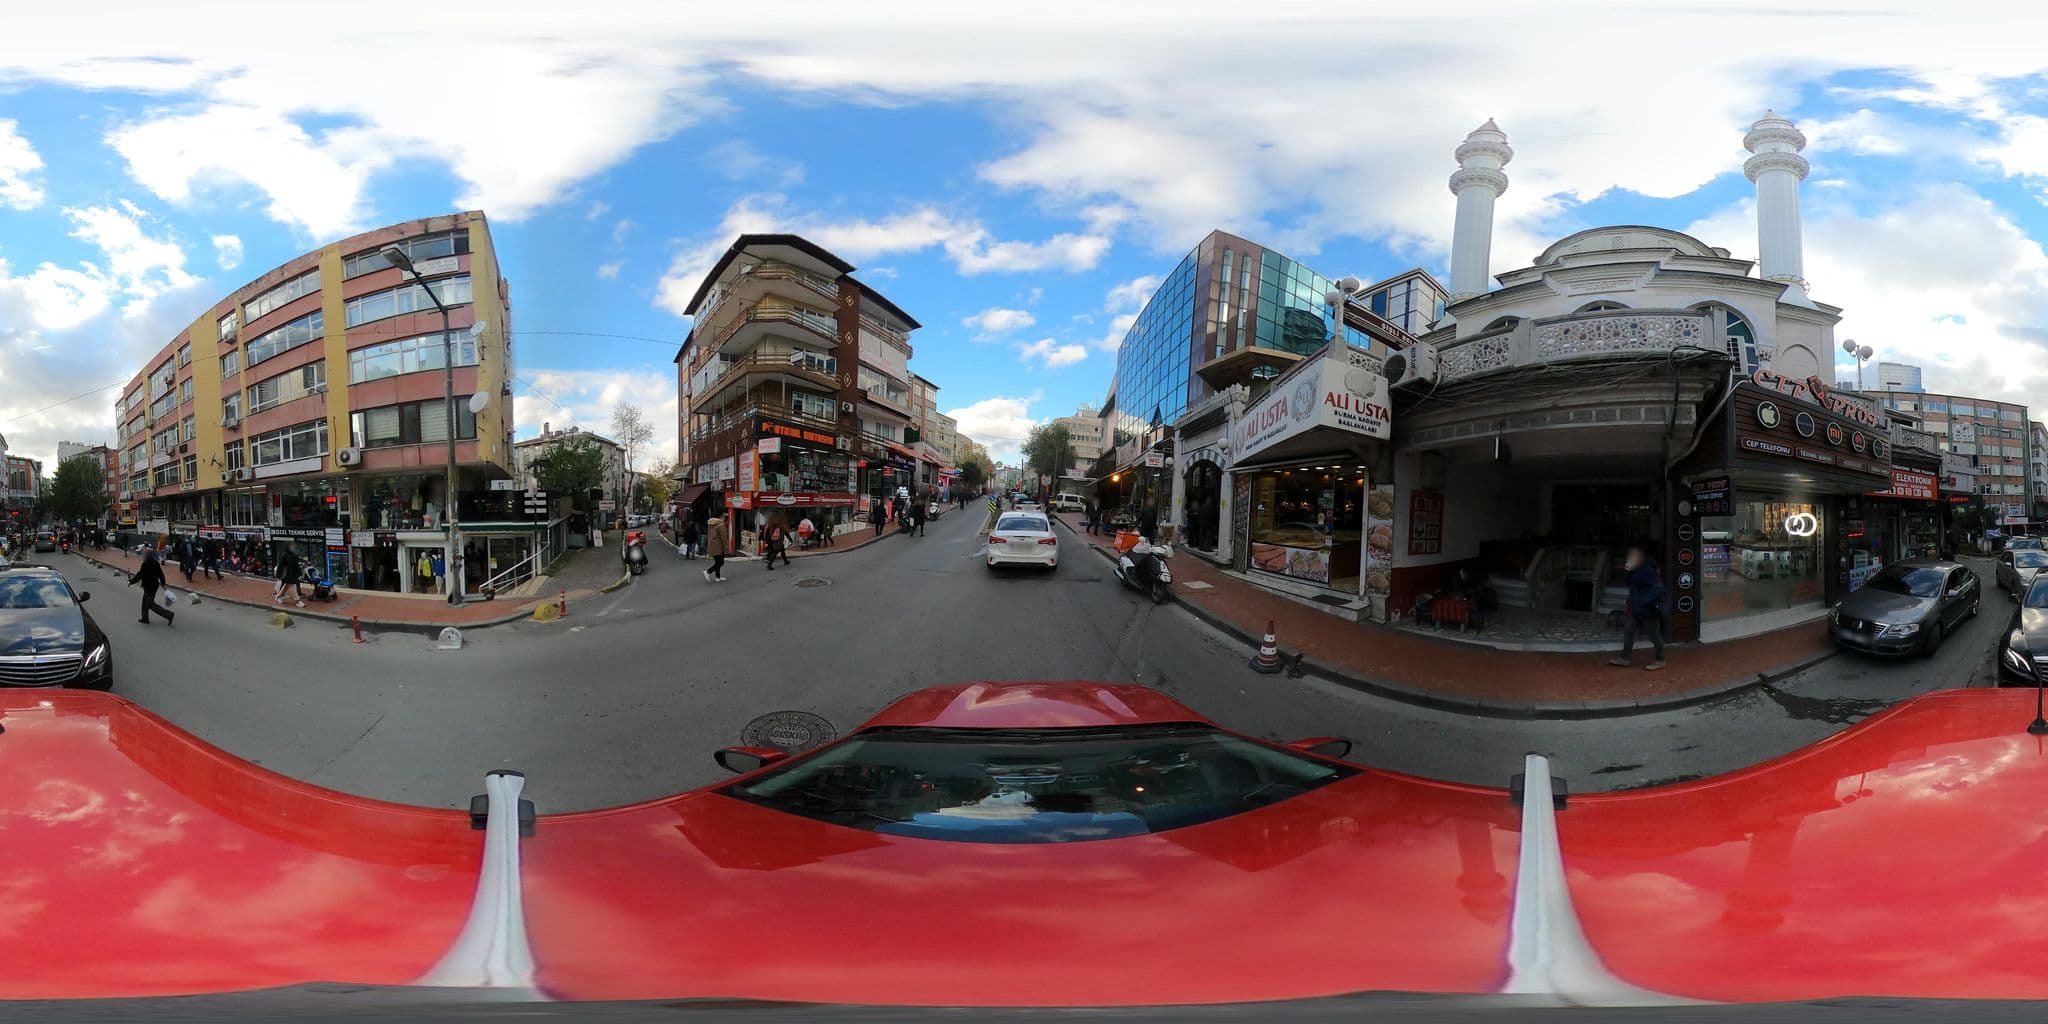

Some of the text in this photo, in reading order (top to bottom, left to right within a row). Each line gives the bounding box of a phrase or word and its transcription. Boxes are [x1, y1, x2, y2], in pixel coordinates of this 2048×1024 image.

[1262, 396, 1288, 431] USTA
[1324, 391, 1389, 422] ALİ USTA
[1338, 419, 1377, 433] BAKLAVALARI
[1746, 440, 1790, 454] CEP TELEFONU
